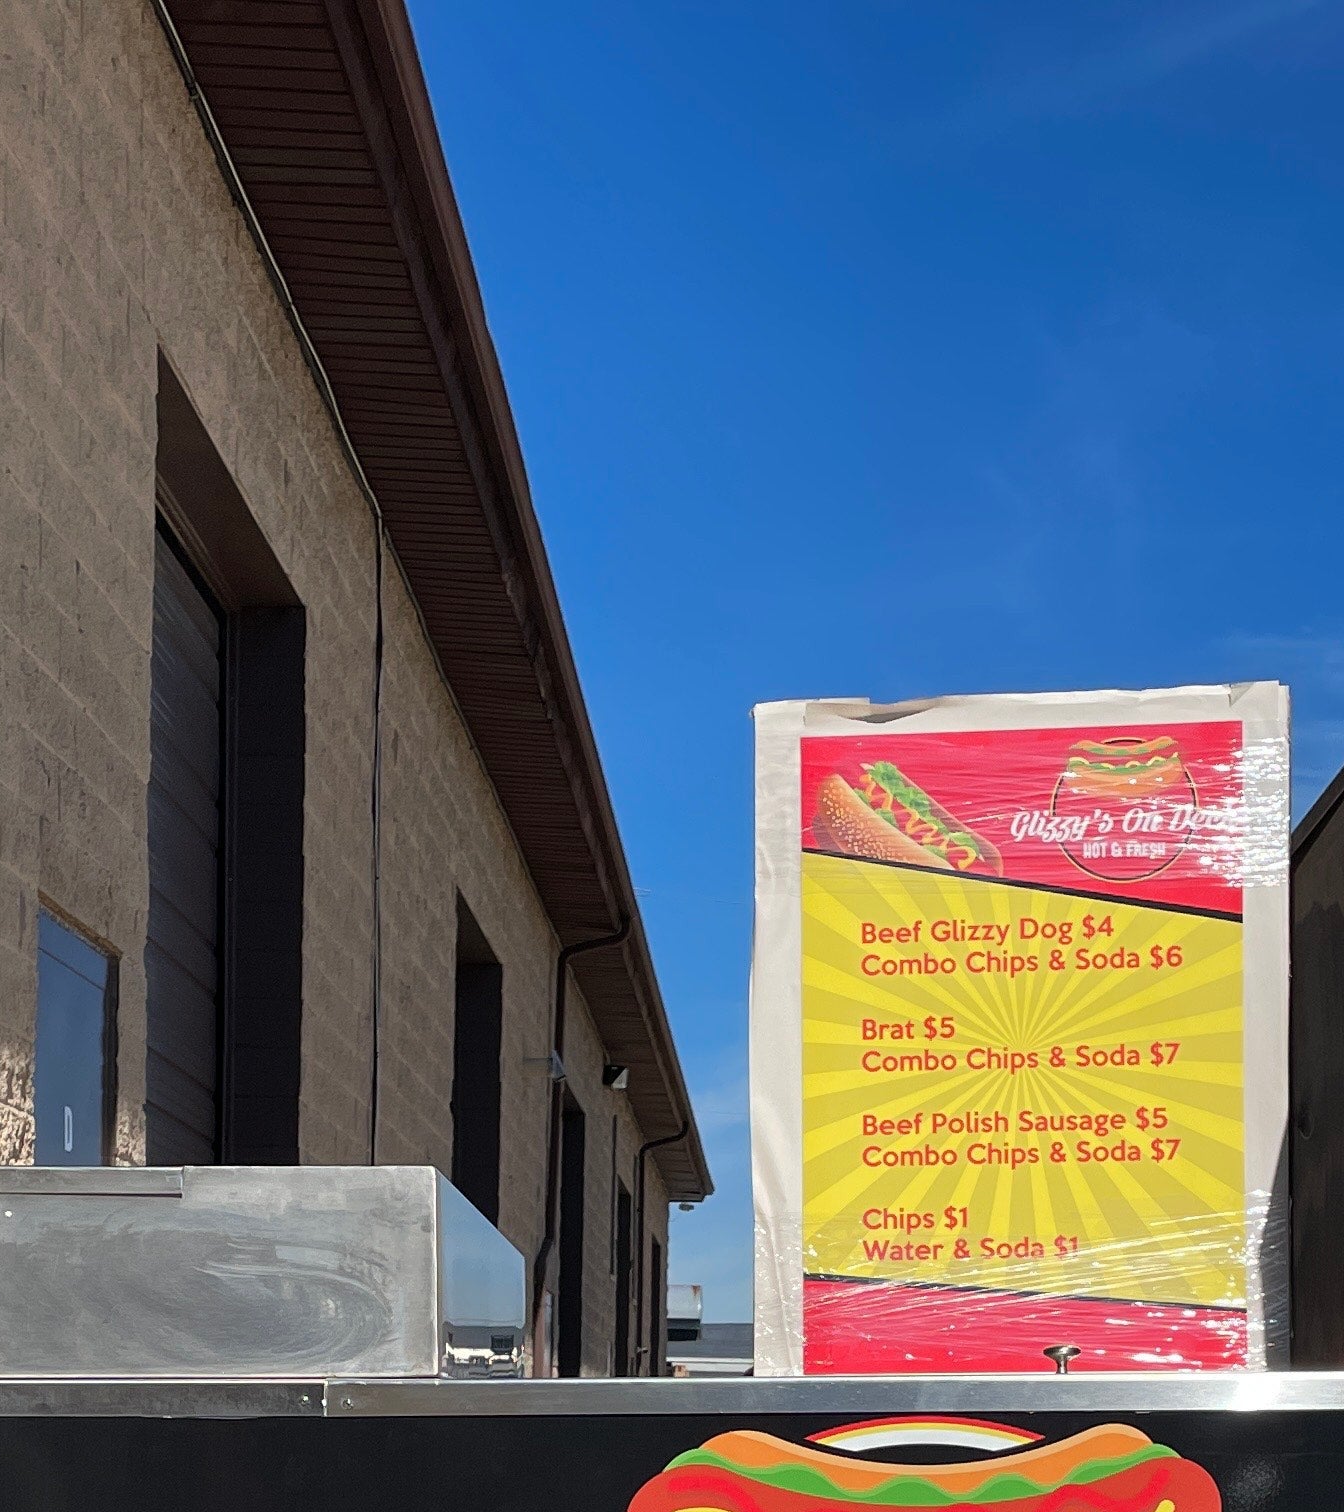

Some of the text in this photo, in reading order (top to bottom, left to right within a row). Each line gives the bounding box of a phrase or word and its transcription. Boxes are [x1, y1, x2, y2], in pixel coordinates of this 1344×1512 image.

[1010, 808, 1114, 843] Glizzy's
[1121, 807, 1164, 833] On
[1082, 842, 1166, 861] HOT & FRESH
[861, 914, 1114, 946] Beef Glizzy Dog $4
[860, 944, 1183, 978] Combo Chips & Soda $6
[862, 1015, 956, 1041] Brat $5
[861, 1041, 1181, 1075] Combo Chips & Soda $7
[862, 1106, 1168, 1137] Beef Polish Sausage $5
[861, 1137, 1182, 1170] Combo Chips & Soda $7
[861, 1205, 969, 1234] Chips $1
[862, 1240, 944, 1261] Water
[953, 1238, 971, 1260] &
[980, 1236, 1045, 1260] Soda
